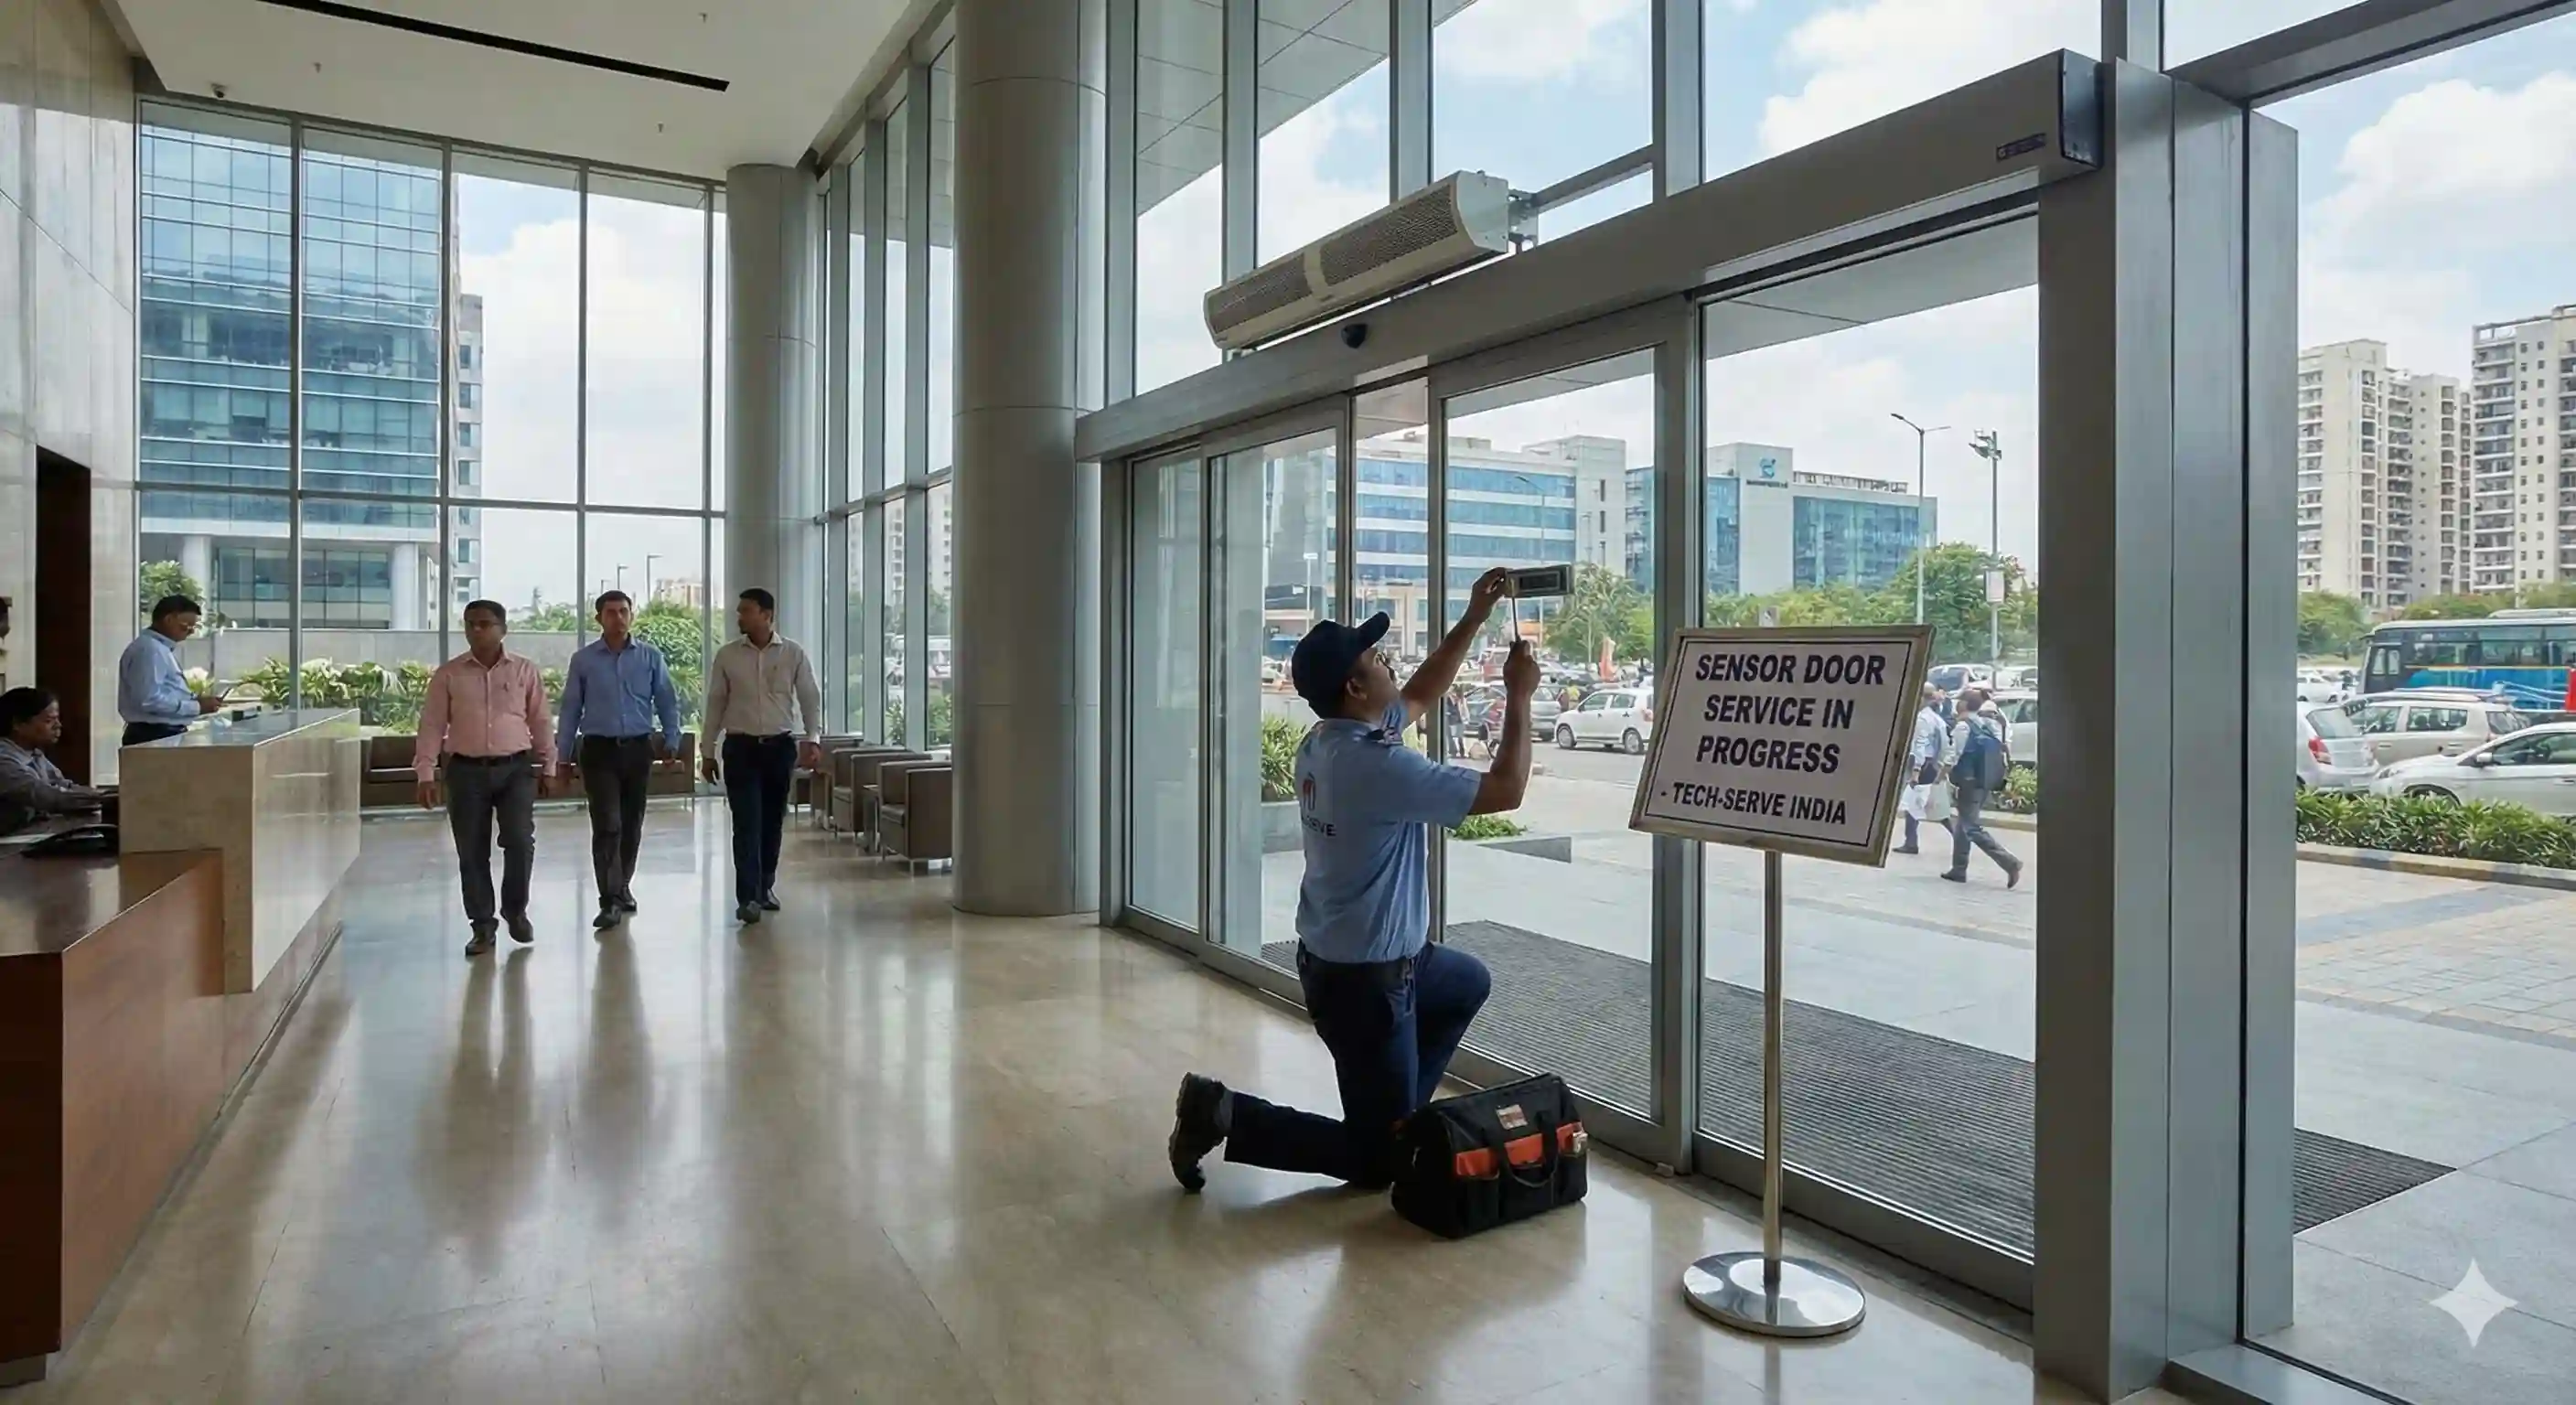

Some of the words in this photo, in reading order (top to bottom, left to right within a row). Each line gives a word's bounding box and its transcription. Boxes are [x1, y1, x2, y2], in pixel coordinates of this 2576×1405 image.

[1695, 653, 1797, 683] SENSOR
[1803, 654, 1886, 685] DOOR
[1704, 694, 1817, 727] SERVICE
[1821, 698, 1854, 730] IN
[1696, 735, 1841, 774] PROGRESS
[1673, 782, 1787, 817] TECH-SERVE
[1789, 795, 1846, 824] INDIA
